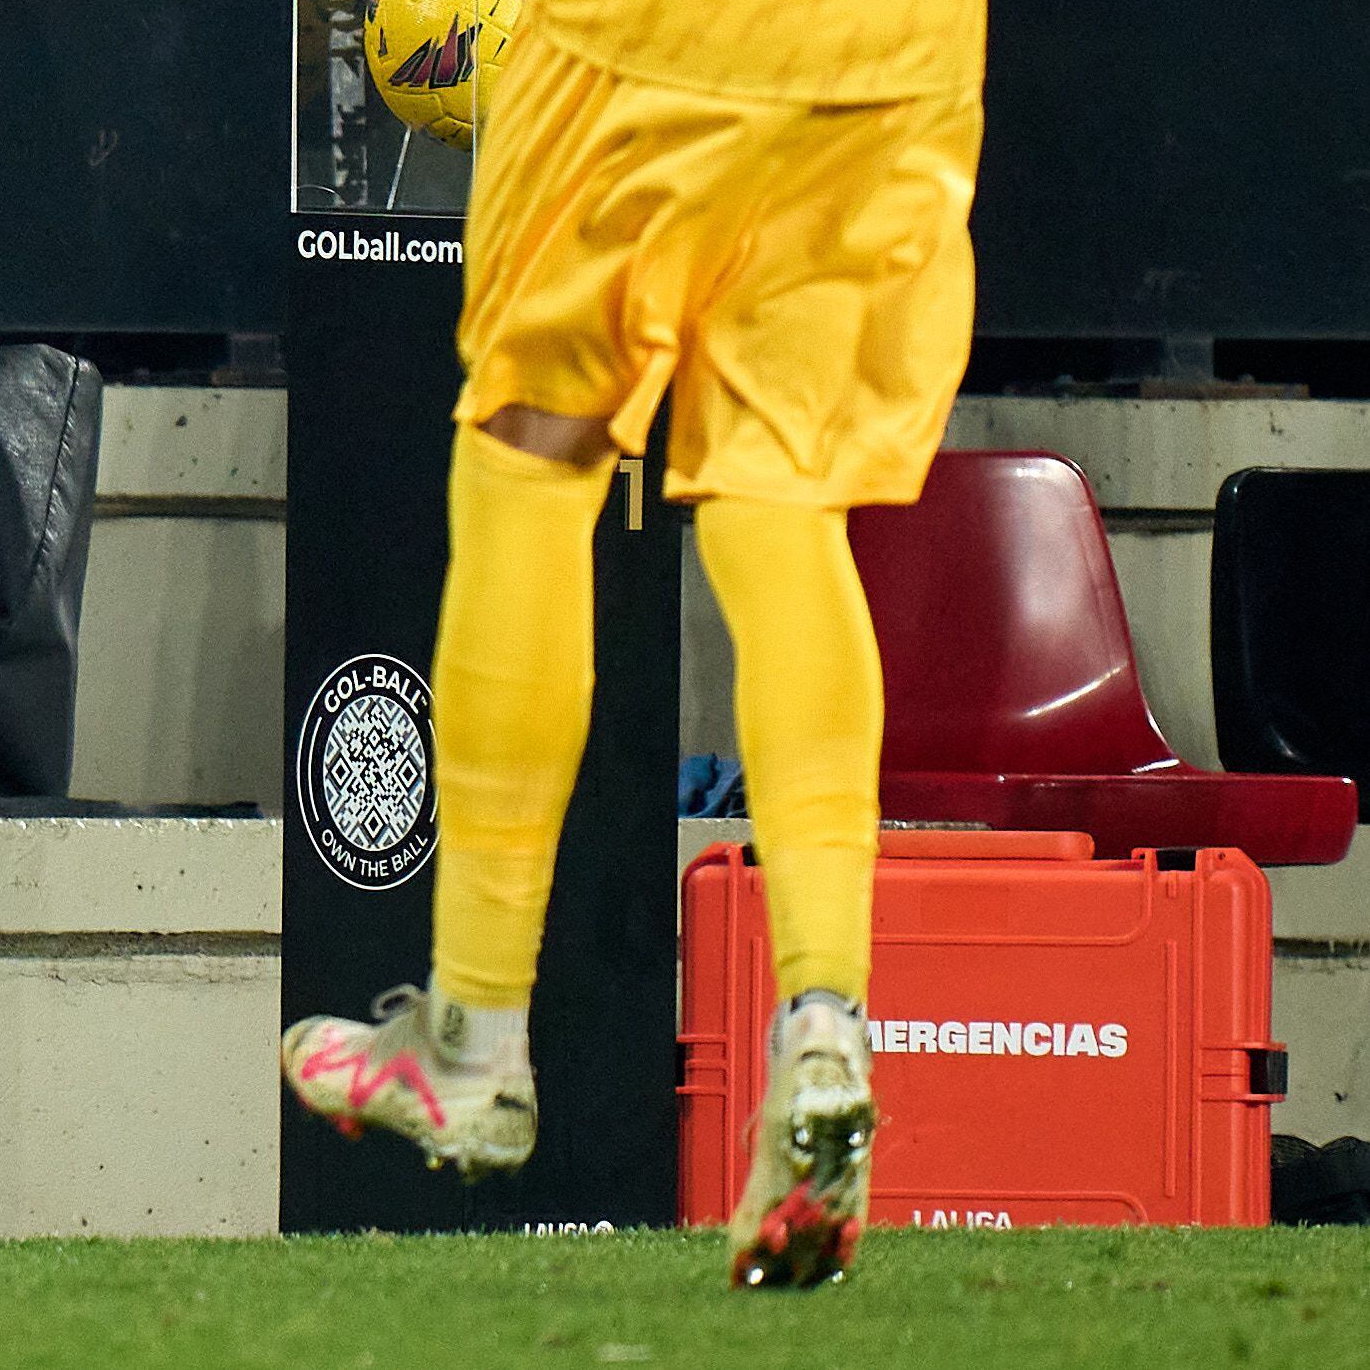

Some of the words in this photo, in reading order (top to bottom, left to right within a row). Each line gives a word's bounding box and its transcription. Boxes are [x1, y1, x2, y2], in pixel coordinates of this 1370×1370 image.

[297, 229, 463, 264] GOLball.com
[321, 828, 357, 872] OWN
[359, 858, 389, 878] THE
[391, 833, 429, 873] BALL
[867, 1020, 1129, 1058] ERGENCIAS
